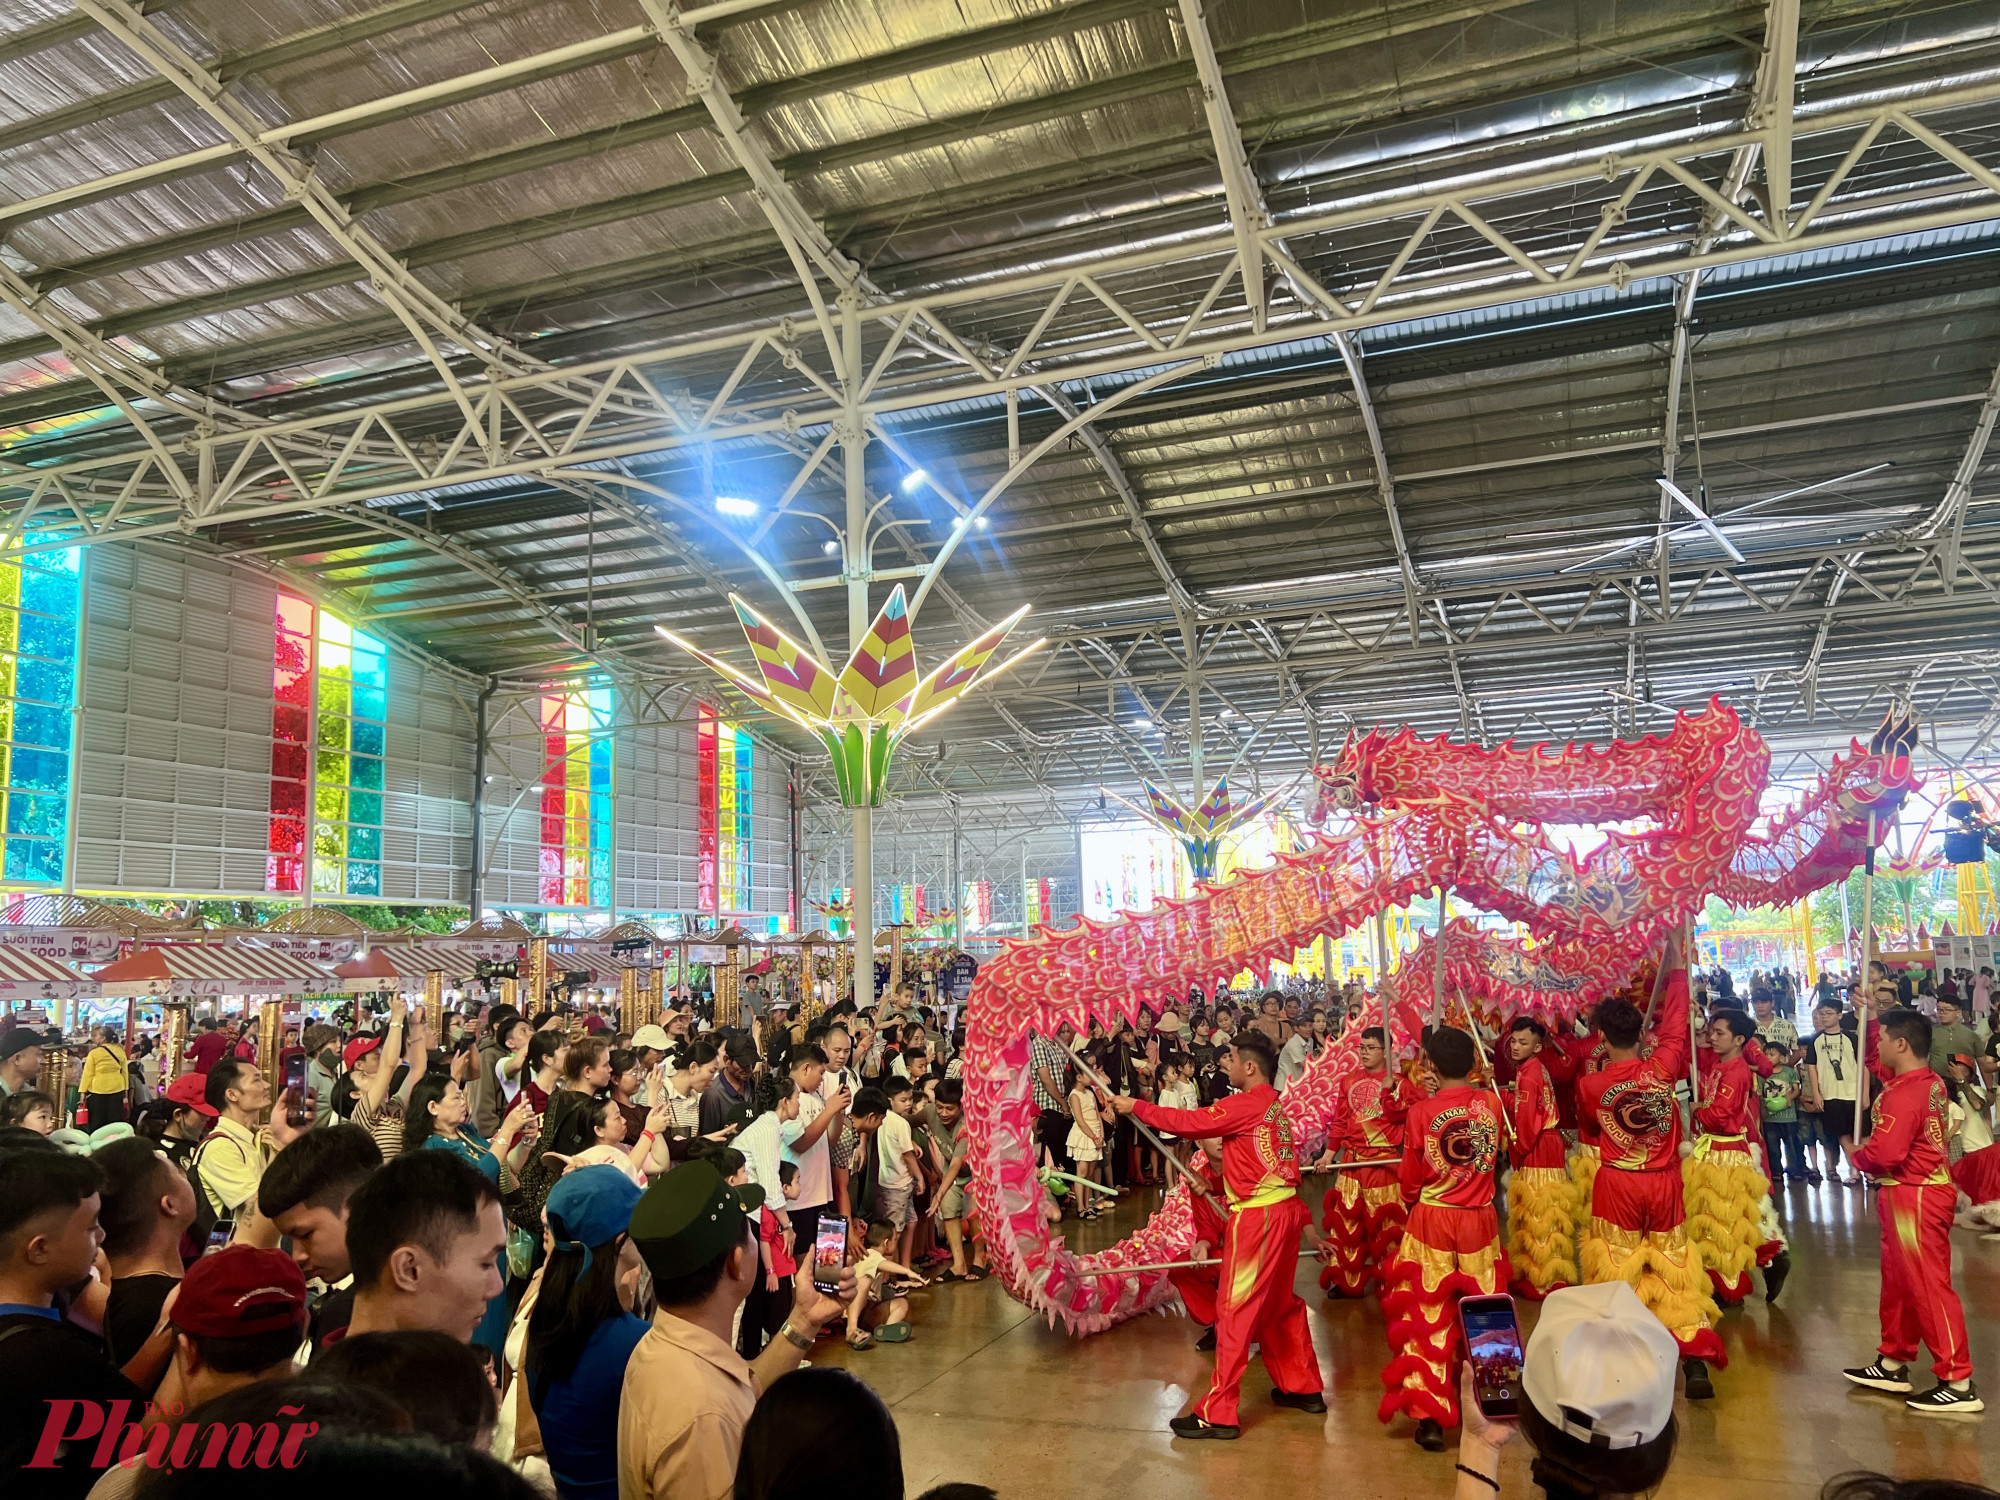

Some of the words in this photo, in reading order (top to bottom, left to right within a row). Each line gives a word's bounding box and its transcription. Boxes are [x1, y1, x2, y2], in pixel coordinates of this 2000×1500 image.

[31, 934, 54, 945] TIÊN
[72, 941, 87, 950] 04
[31, 948, 67, 958] FOOD
[1602, 1081, 1637, 1106] VIETNAM
[1431, 1107, 1467, 1131] VIETNAM
